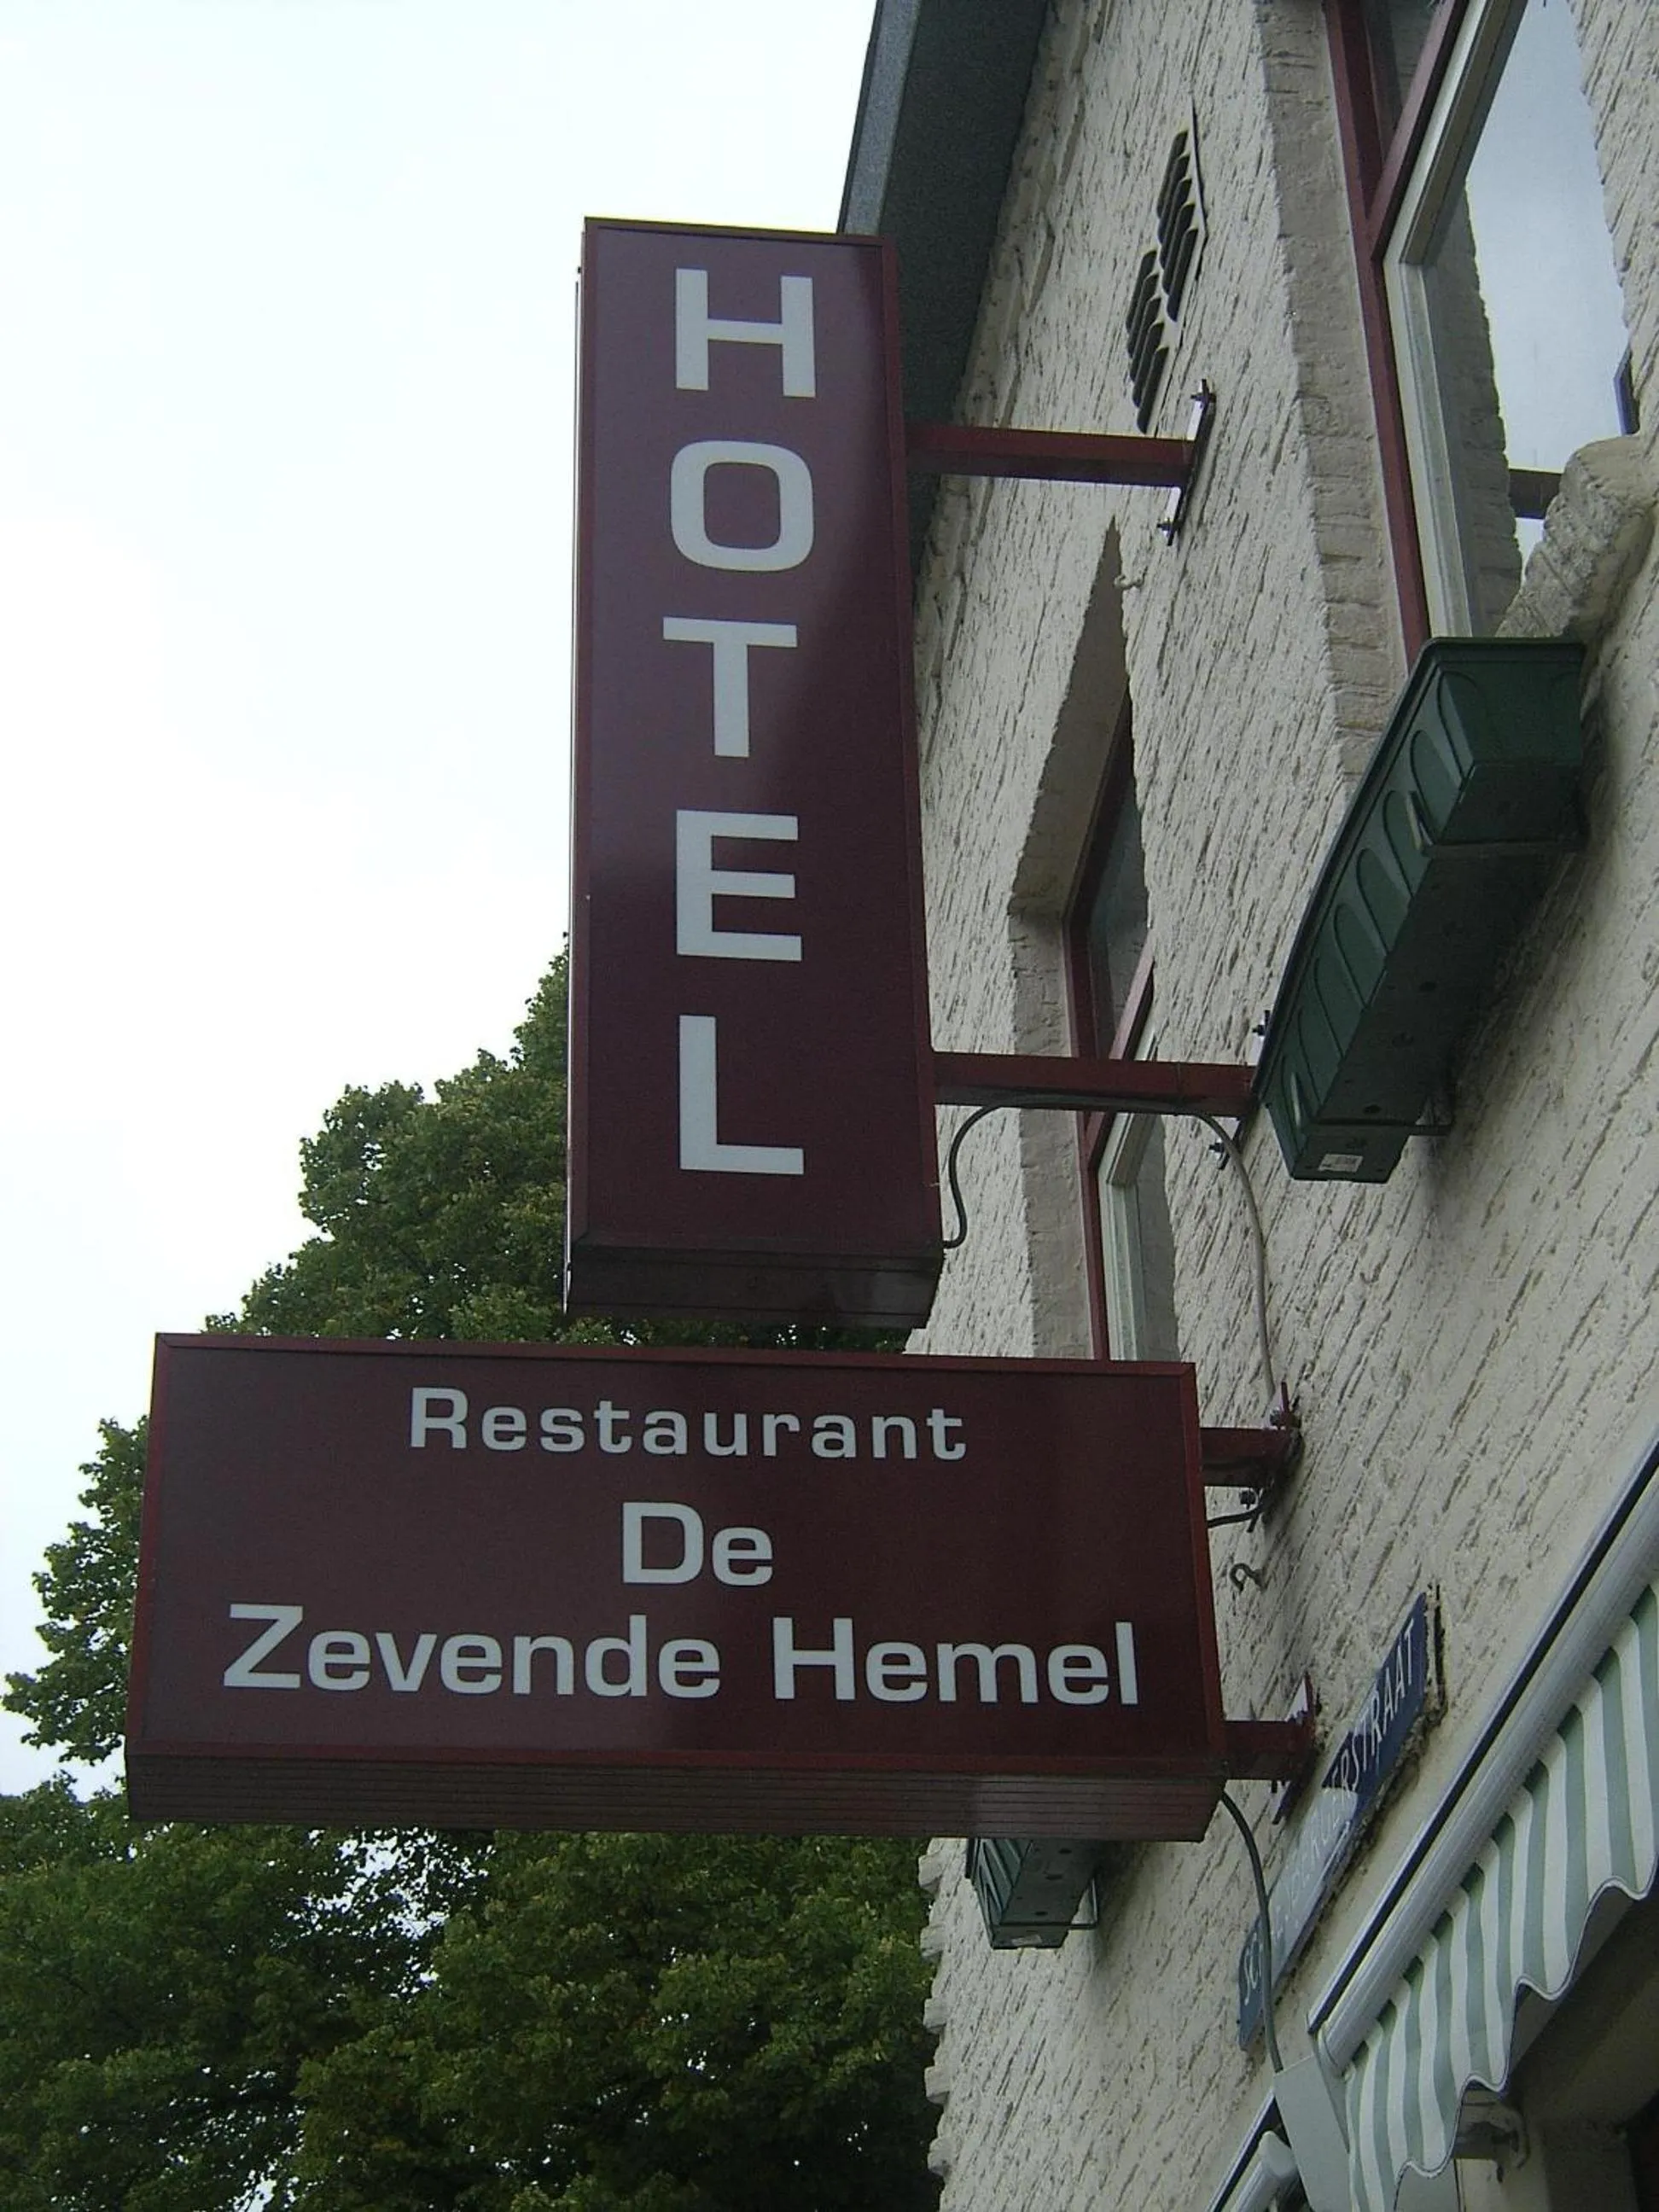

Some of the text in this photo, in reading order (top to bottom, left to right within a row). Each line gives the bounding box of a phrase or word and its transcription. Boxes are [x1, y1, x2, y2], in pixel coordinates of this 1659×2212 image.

[662, 268, 816, 1175] HOTEL
[410, 1387, 967, 1461] Restaurant
[622, 1502, 773, 1586] De
[224, 1604, 1138, 1705] Zevende Hemel
